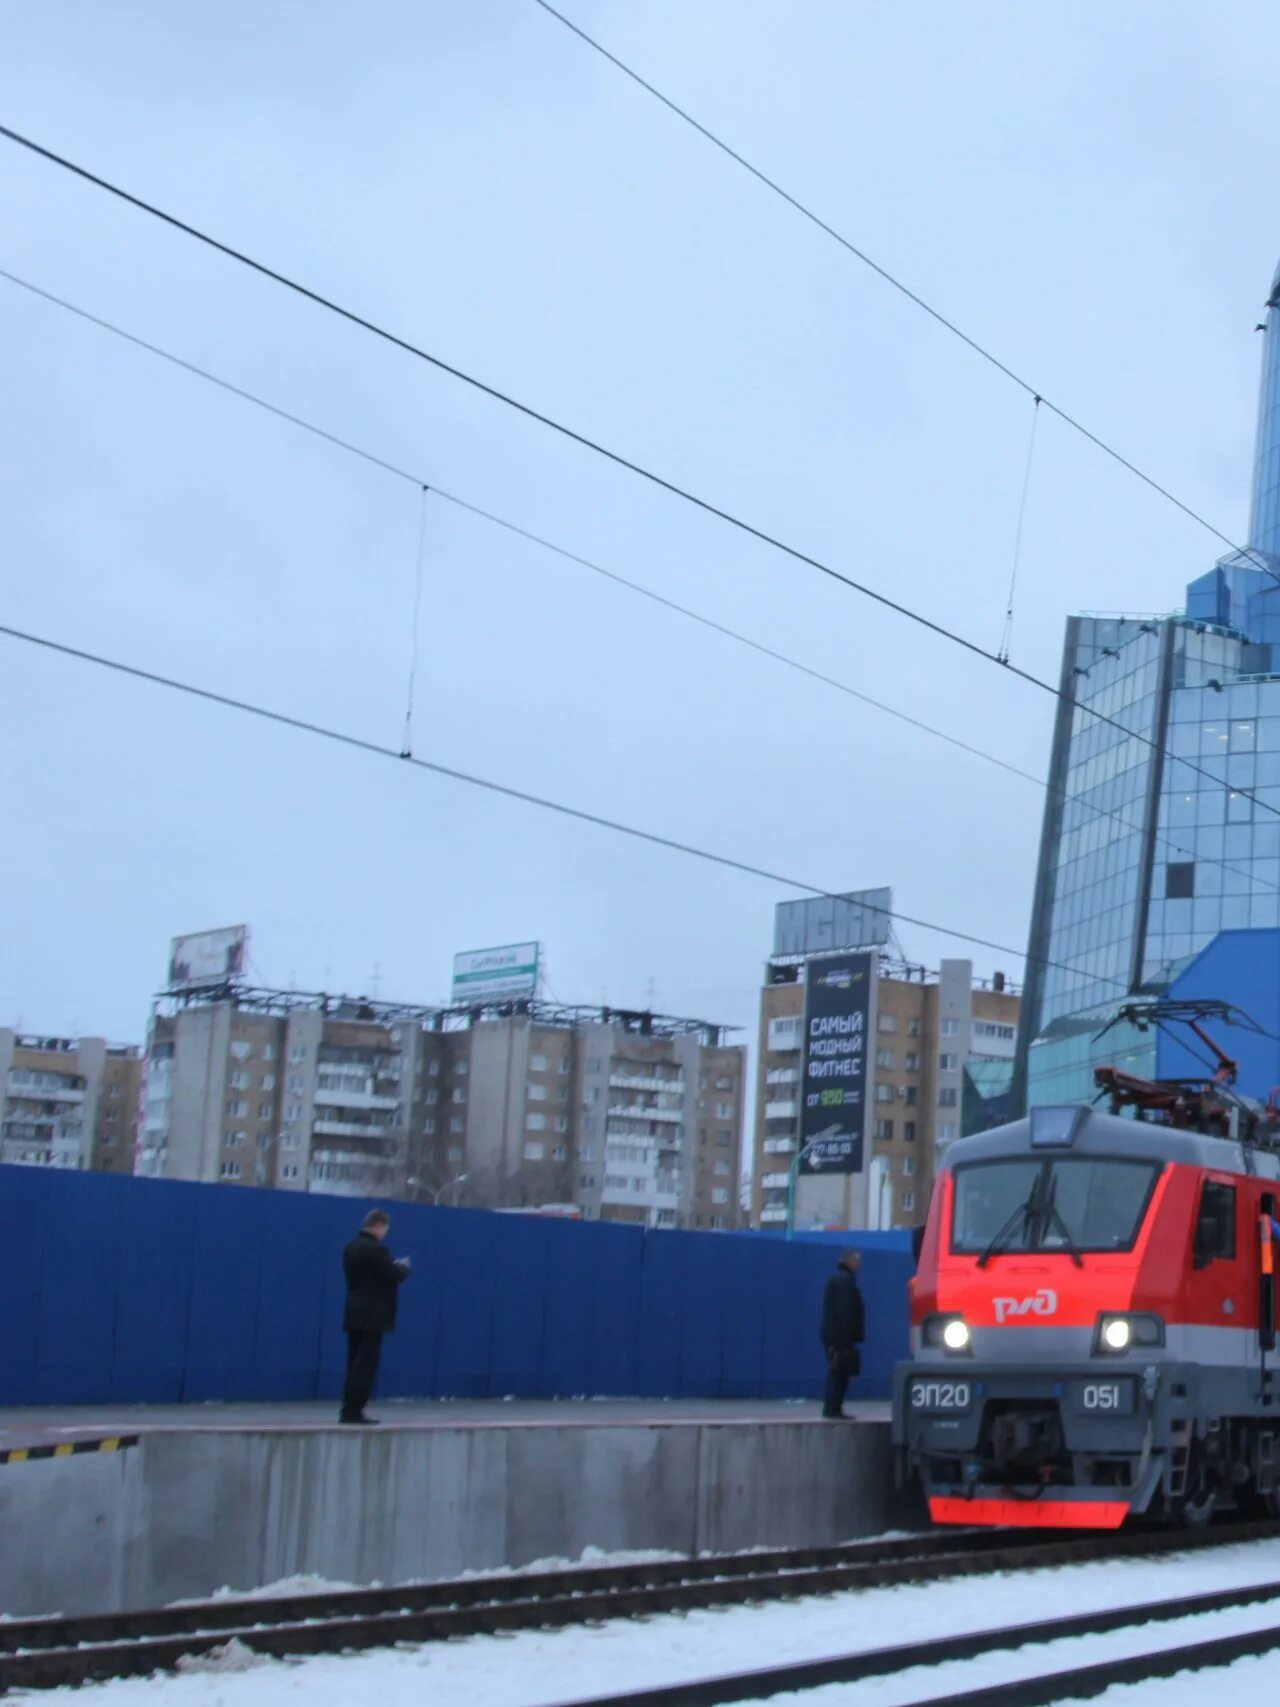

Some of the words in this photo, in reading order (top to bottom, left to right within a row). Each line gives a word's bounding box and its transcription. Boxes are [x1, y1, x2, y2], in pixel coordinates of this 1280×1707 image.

[810, 1011, 863, 1036] САМЫЙ
[809, 1034, 862, 1056] МОДНЫЙ
[808, 1058, 861, 1078] ФИТНЕС
[992, 1288, 1057, 1323] РЖД
[911, 1383, 970, 1408] ЭП20
[1084, 1385, 1119, 1409] 051
